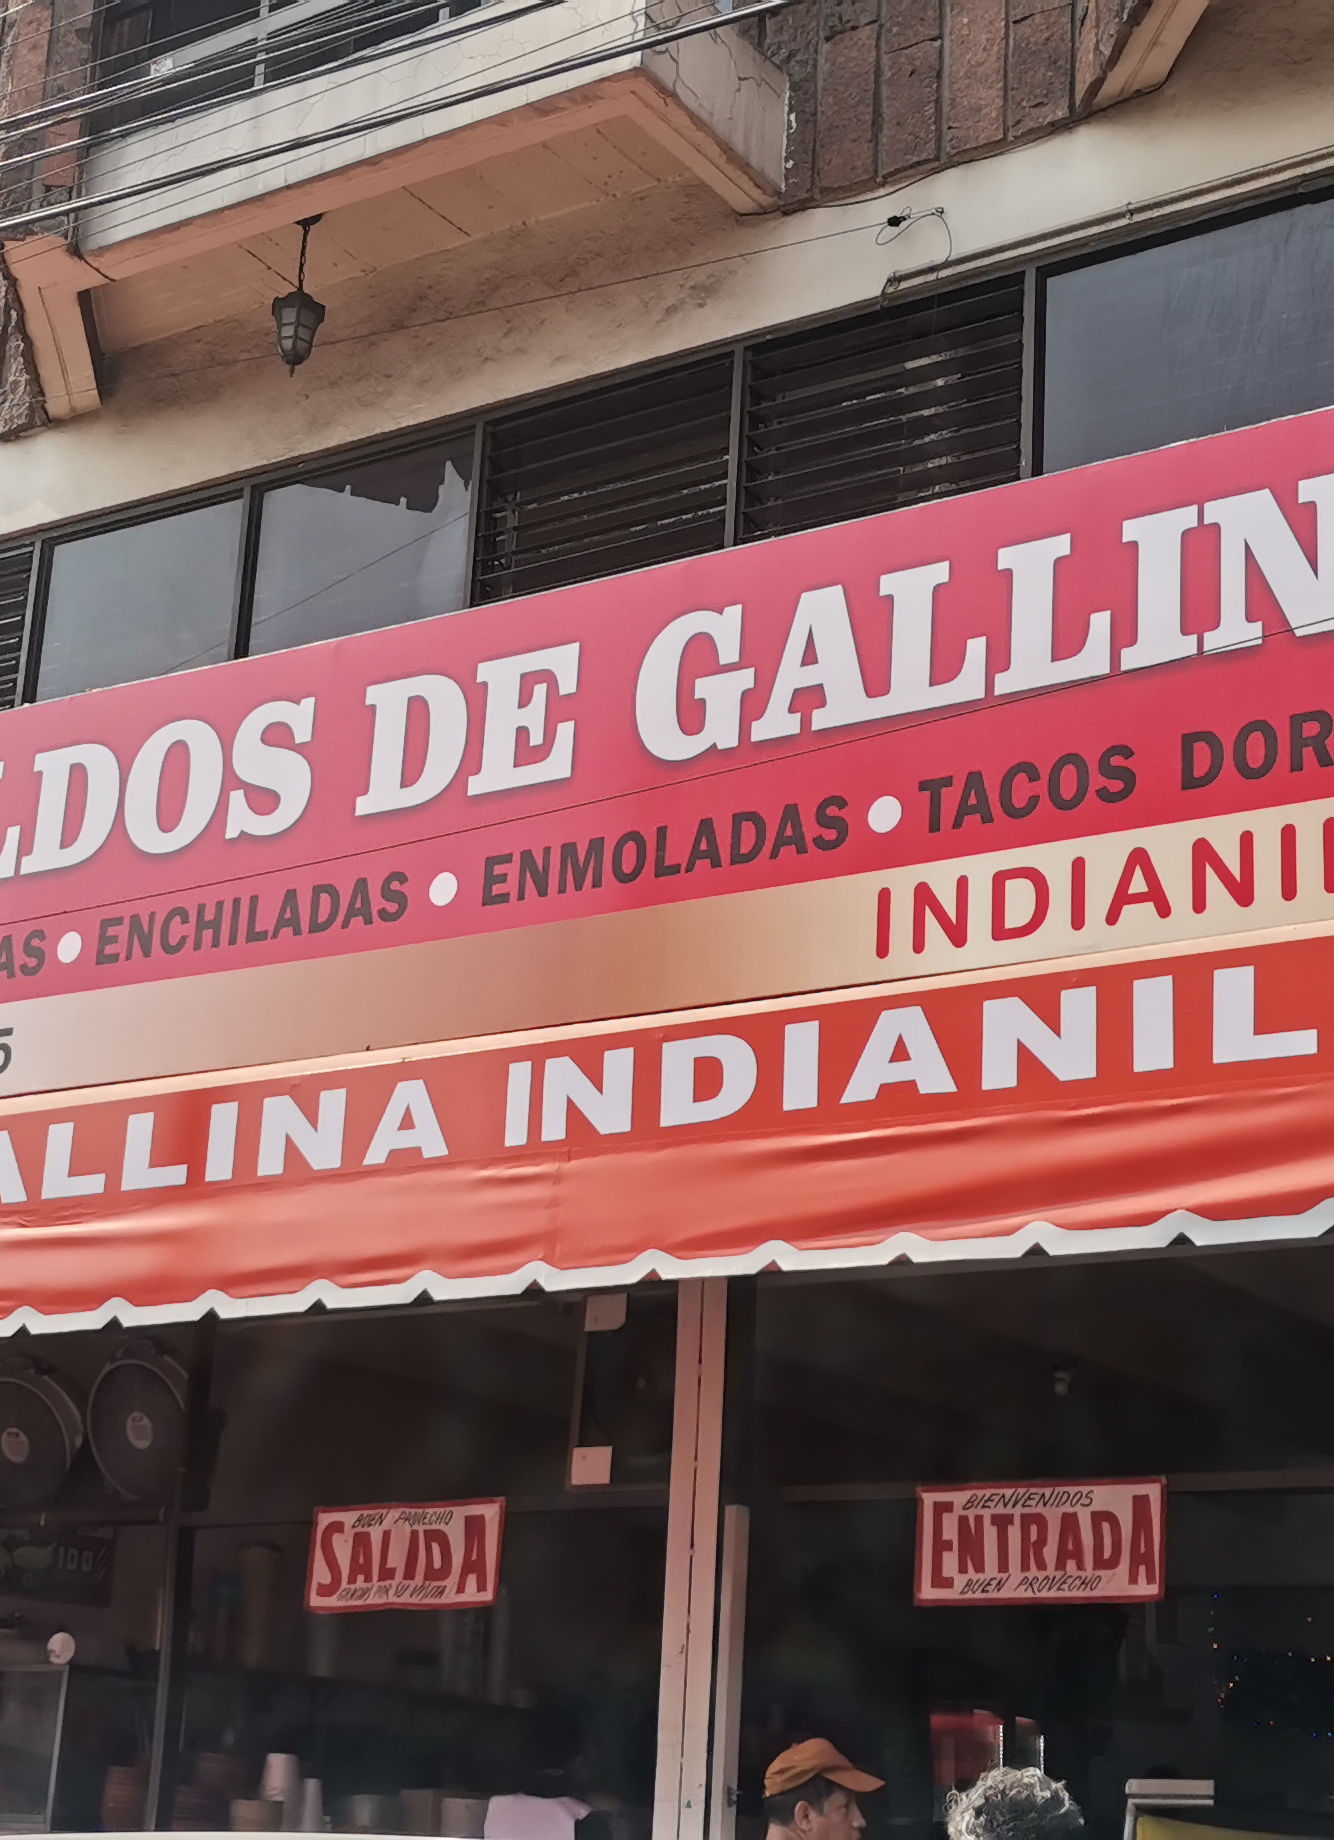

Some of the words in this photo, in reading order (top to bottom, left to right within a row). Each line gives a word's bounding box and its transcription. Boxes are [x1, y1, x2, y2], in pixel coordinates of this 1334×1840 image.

[355, 642, 581, 817] DE
[94, 870, 409, 966] ENCHILADAS
[481, 795, 849, 907] ENMOLADAS
[917, 744, 1137, 834] TACOS
[930, 1494, 1157, 1589] ENTRADA
[962, 1487, 1094, 1510] BIENVENIDOS
[316, 1513, 488, 1598] SALIDA
[959, 1574, 1010, 1595] BUEN
[1016, 1572, 1102, 1595] PROVECHO
